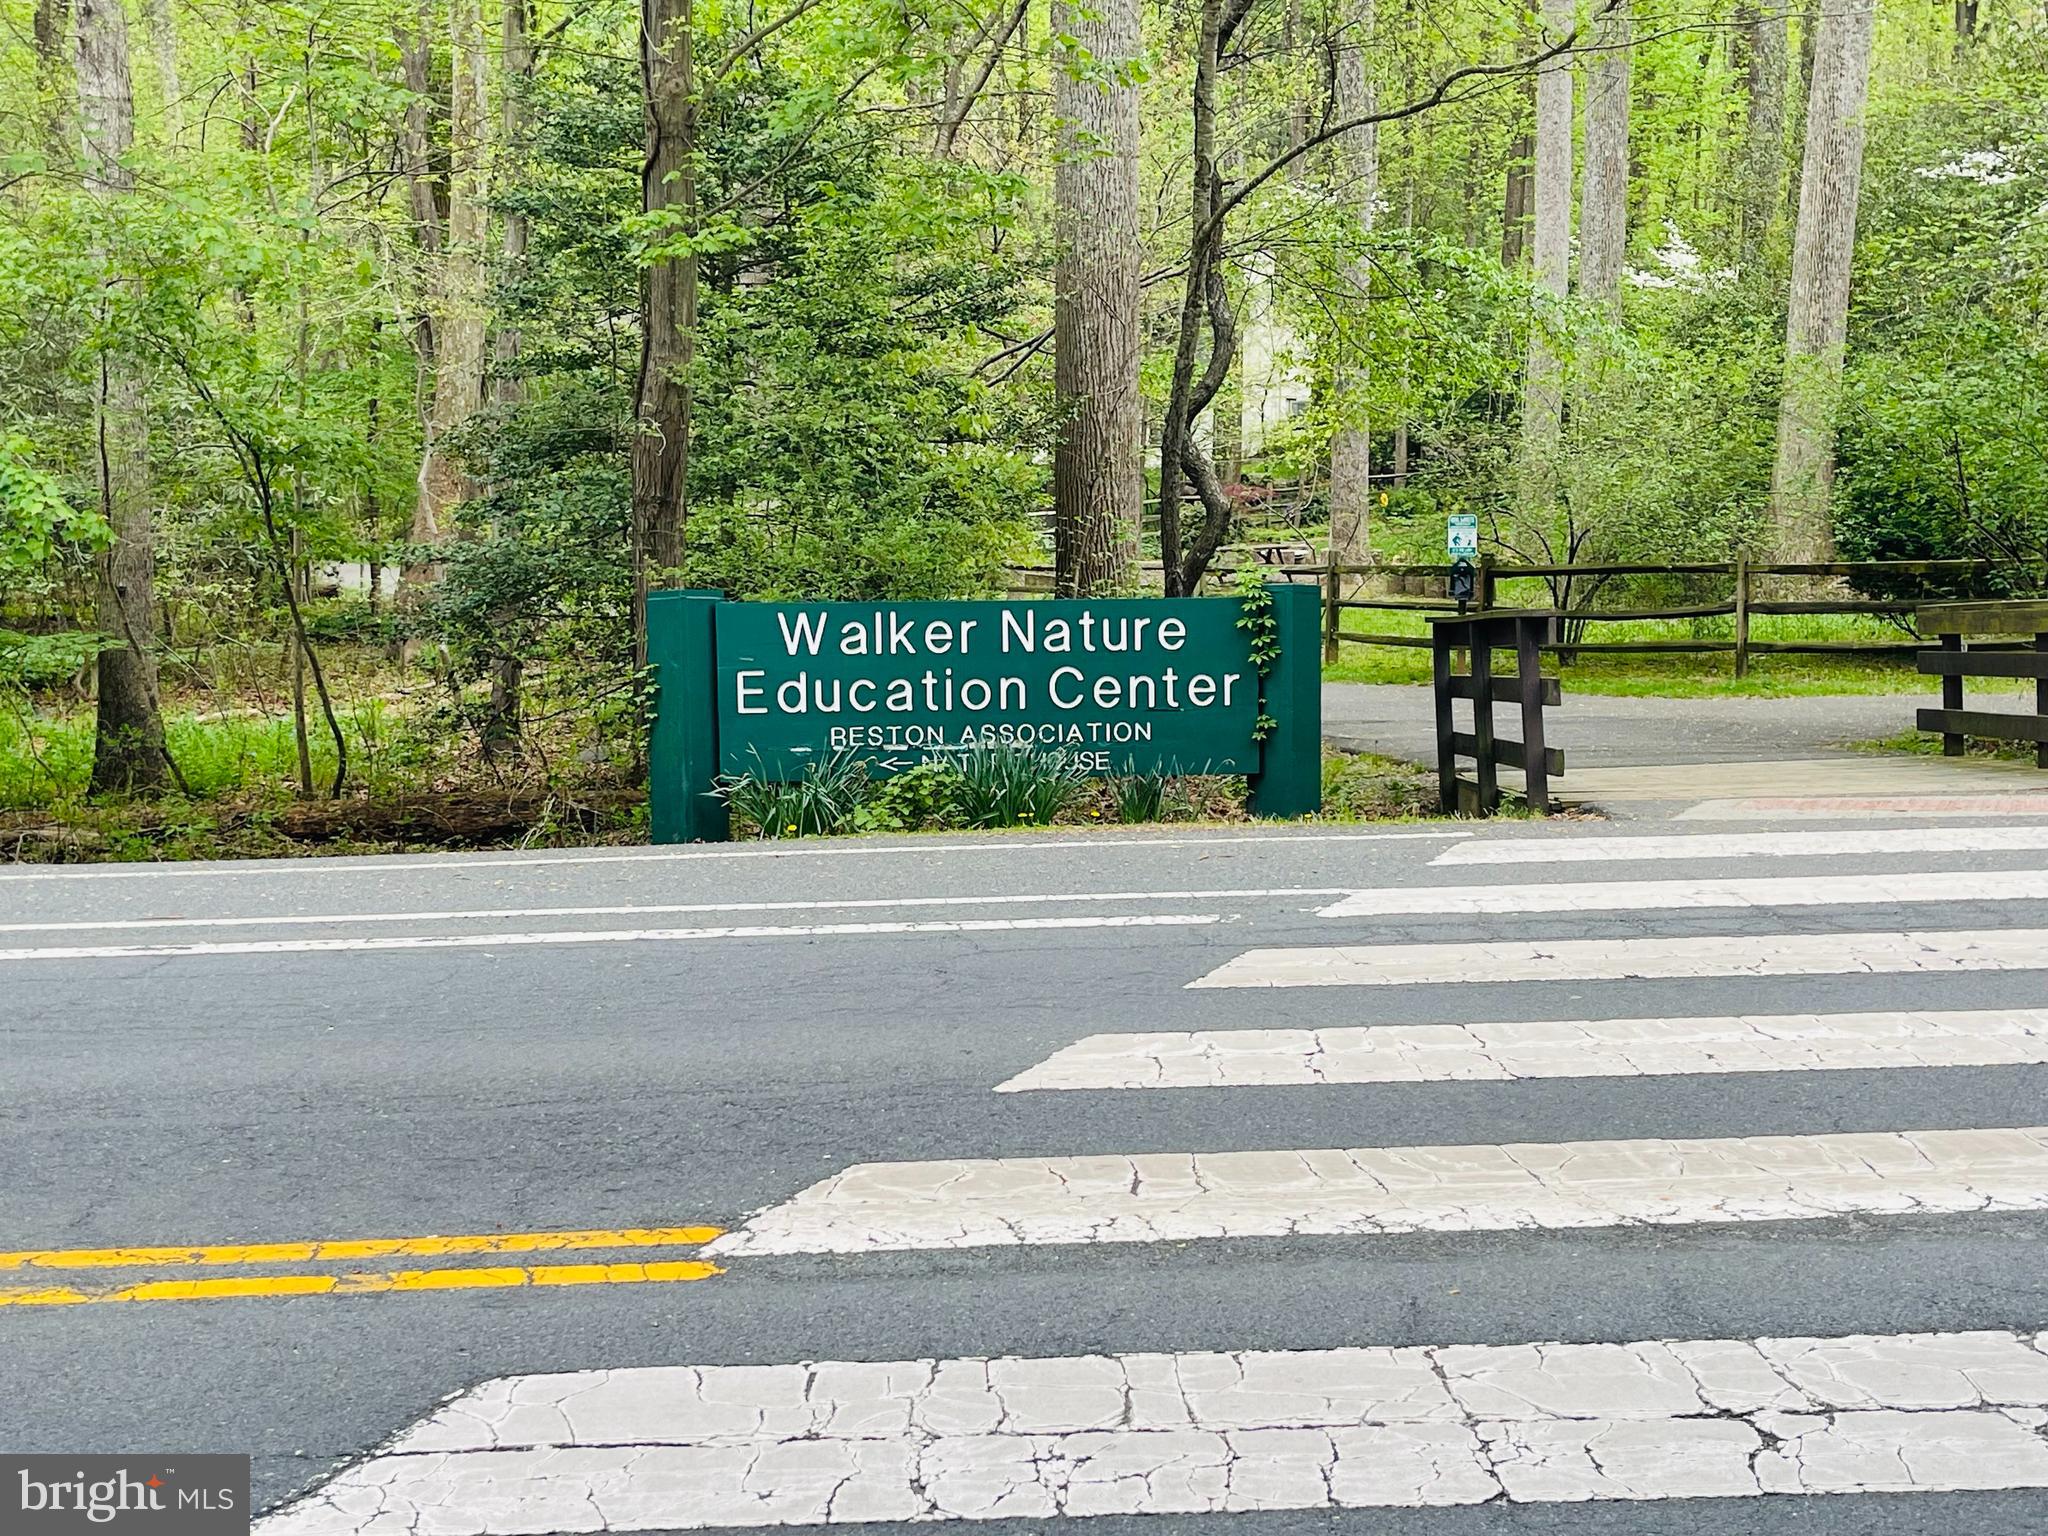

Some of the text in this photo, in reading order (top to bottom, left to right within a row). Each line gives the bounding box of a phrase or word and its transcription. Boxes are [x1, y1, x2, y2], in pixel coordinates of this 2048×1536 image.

[778, 609, 1186, 656] Walker Nature
[737, 666, 1240, 714] Education Center
[830, 721, 1152, 748] RESTON ASSOCIATION
